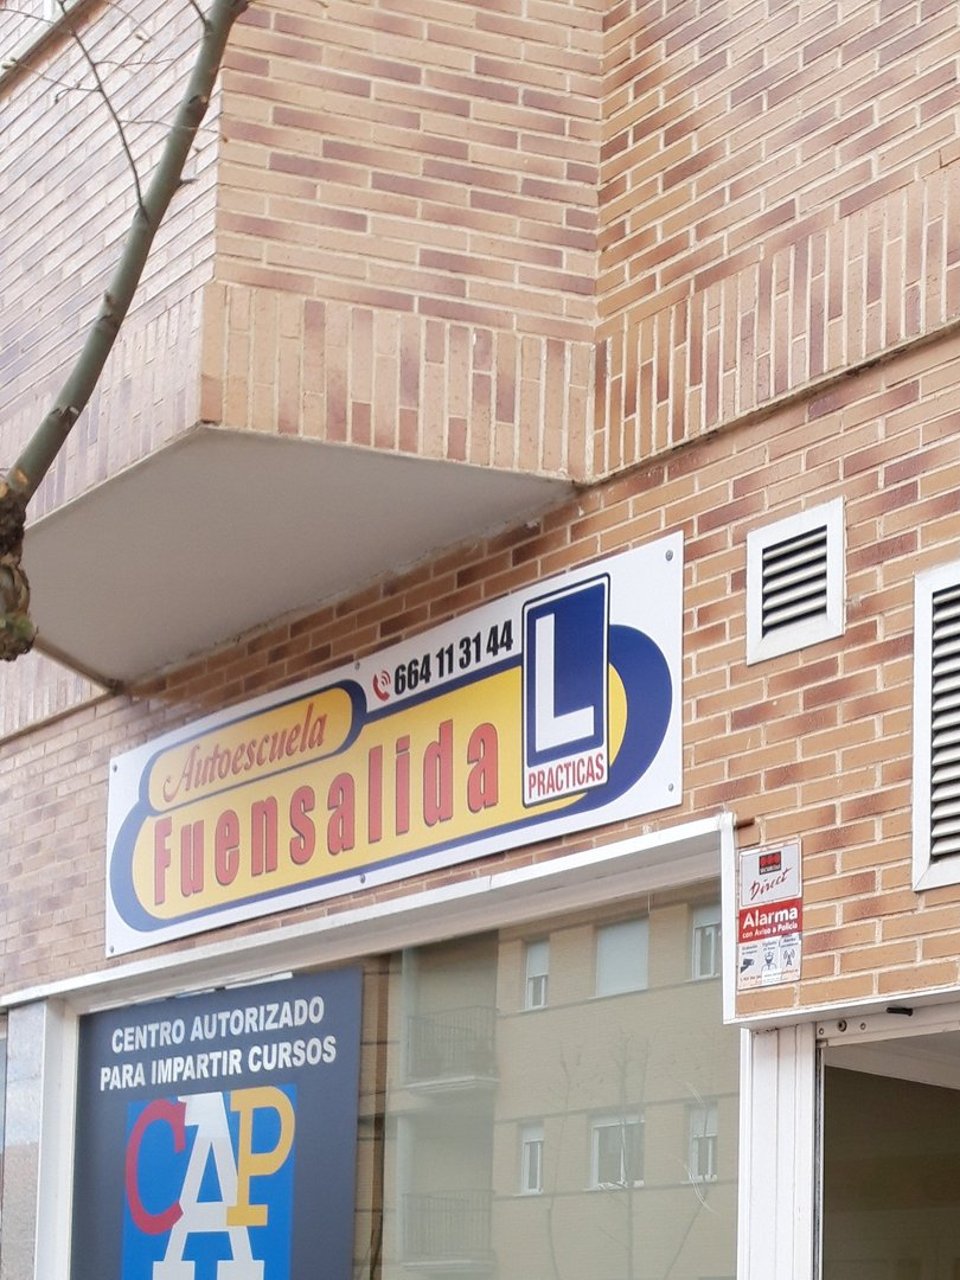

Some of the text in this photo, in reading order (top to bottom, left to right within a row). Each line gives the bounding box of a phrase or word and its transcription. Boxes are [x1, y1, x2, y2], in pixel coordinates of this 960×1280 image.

[394, 619, 514, 695] 664 11 31 44
[535, 613, 594, 753] L
[163, 702, 328, 803] Autoescuela
[527, 752, 604, 800] PRACTICAS
[153, 719, 499, 906] Fuensalida
[750, 867, 792, 901] Direct
[743, 907, 798, 929] Alarma
[743, 931, 753, 939] con
[755, 928, 771, 936] Aviso
[112, 996, 324, 1054] CENTRO AUTORIZADO
[100, 1036, 337, 1091] PARA IMPARTIR CURSOS
